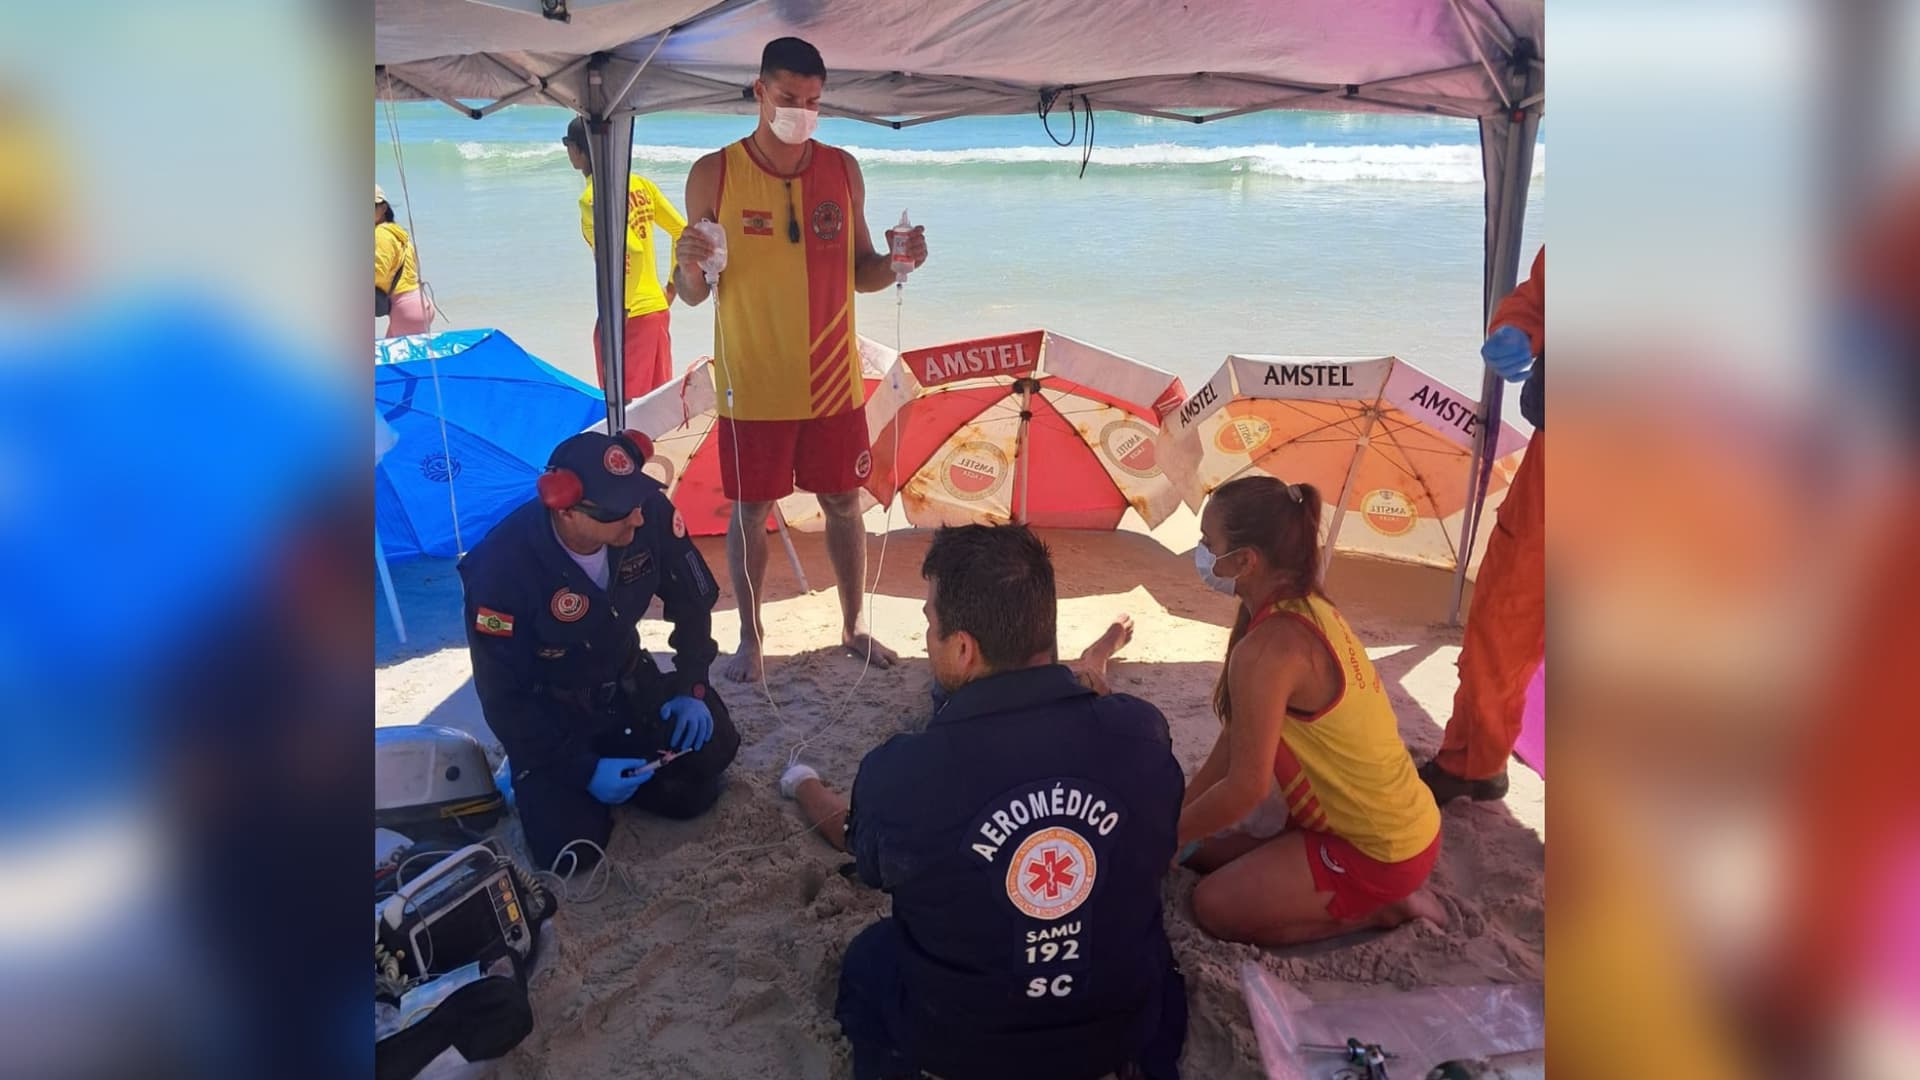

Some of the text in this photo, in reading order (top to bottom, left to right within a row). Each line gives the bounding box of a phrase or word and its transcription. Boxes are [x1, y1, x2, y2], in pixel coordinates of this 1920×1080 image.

[925, 343, 1032, 382] AMSTEL
[1264, 365, 1354, 387] AMSTEL
[1180, 382, 1218, 429] AMSTEL
[1409, 384, 1478, 438] AMSTE
[972, 782, 1119, 862] AEROMÉDICO
[1025, 921, 1081, 943] SAMU
[1025, 940, 1079, 964] 192
[1026, 974, 1073, 998] SC
